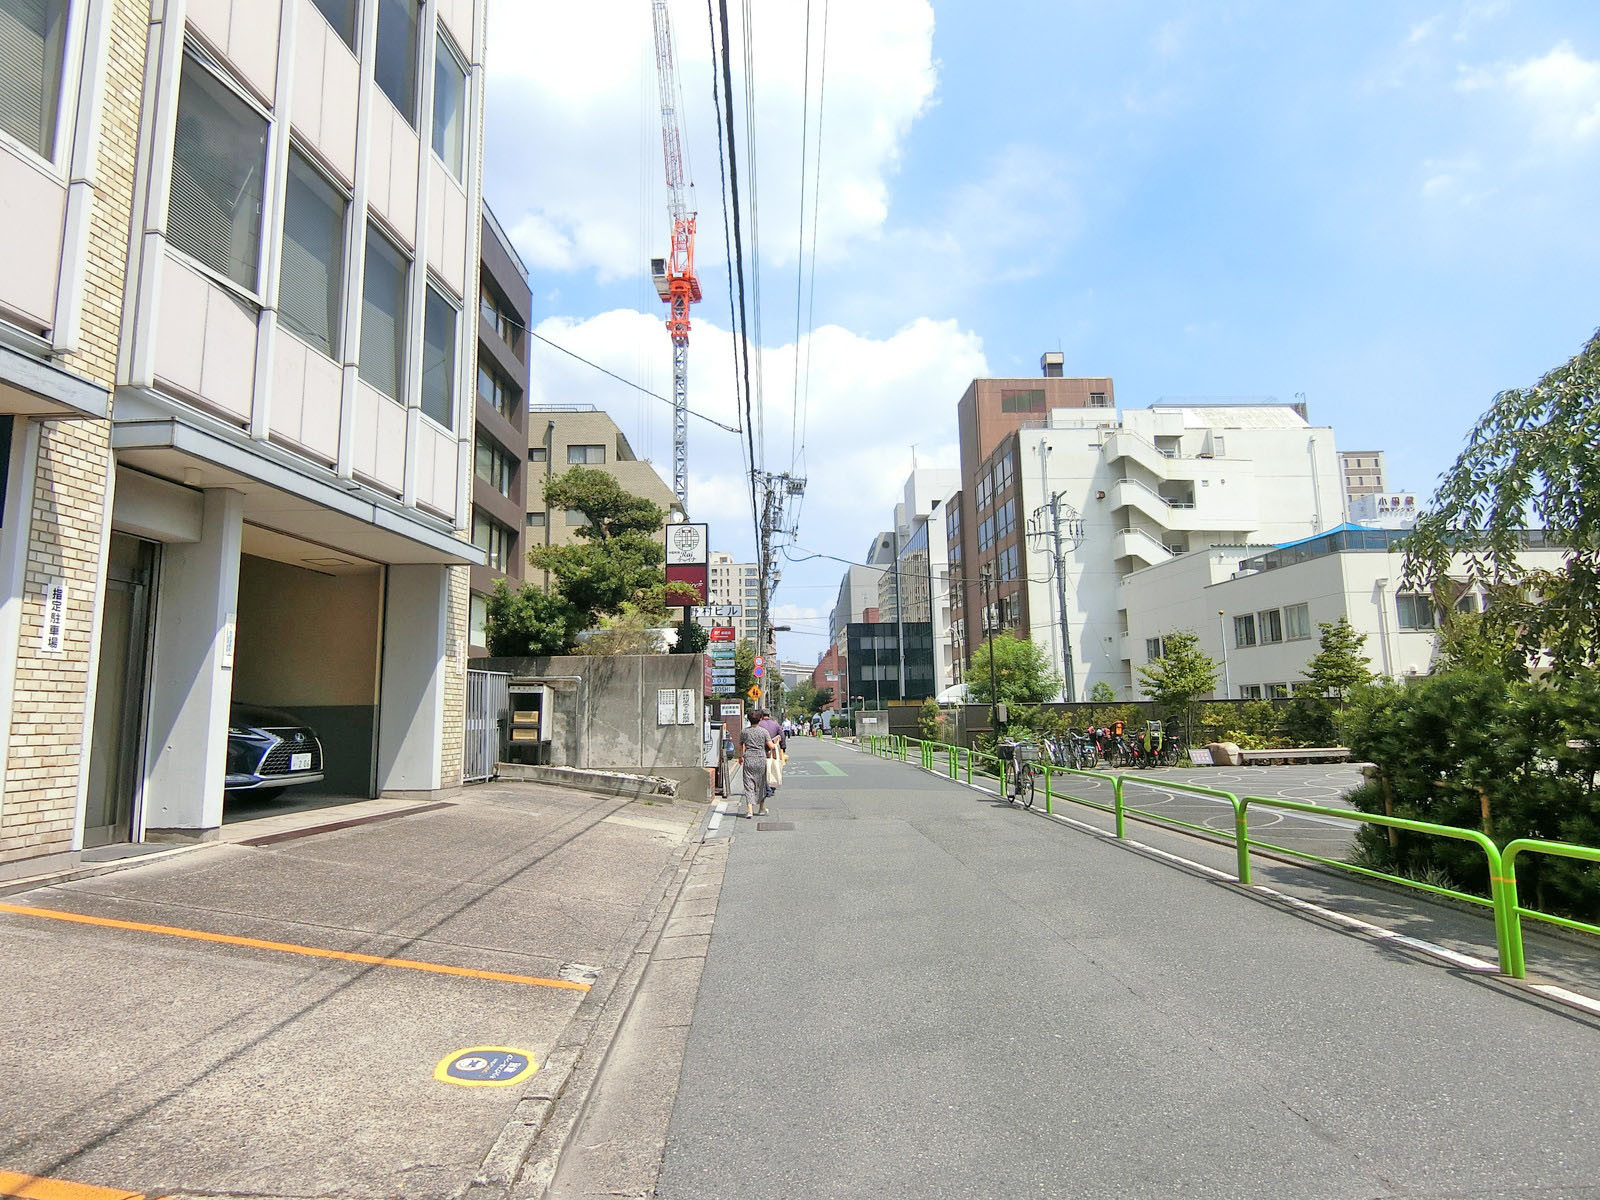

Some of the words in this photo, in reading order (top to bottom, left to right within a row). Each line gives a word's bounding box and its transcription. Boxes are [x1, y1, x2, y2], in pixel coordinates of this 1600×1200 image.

[48, 587, 63, 648] 指定駐車場
